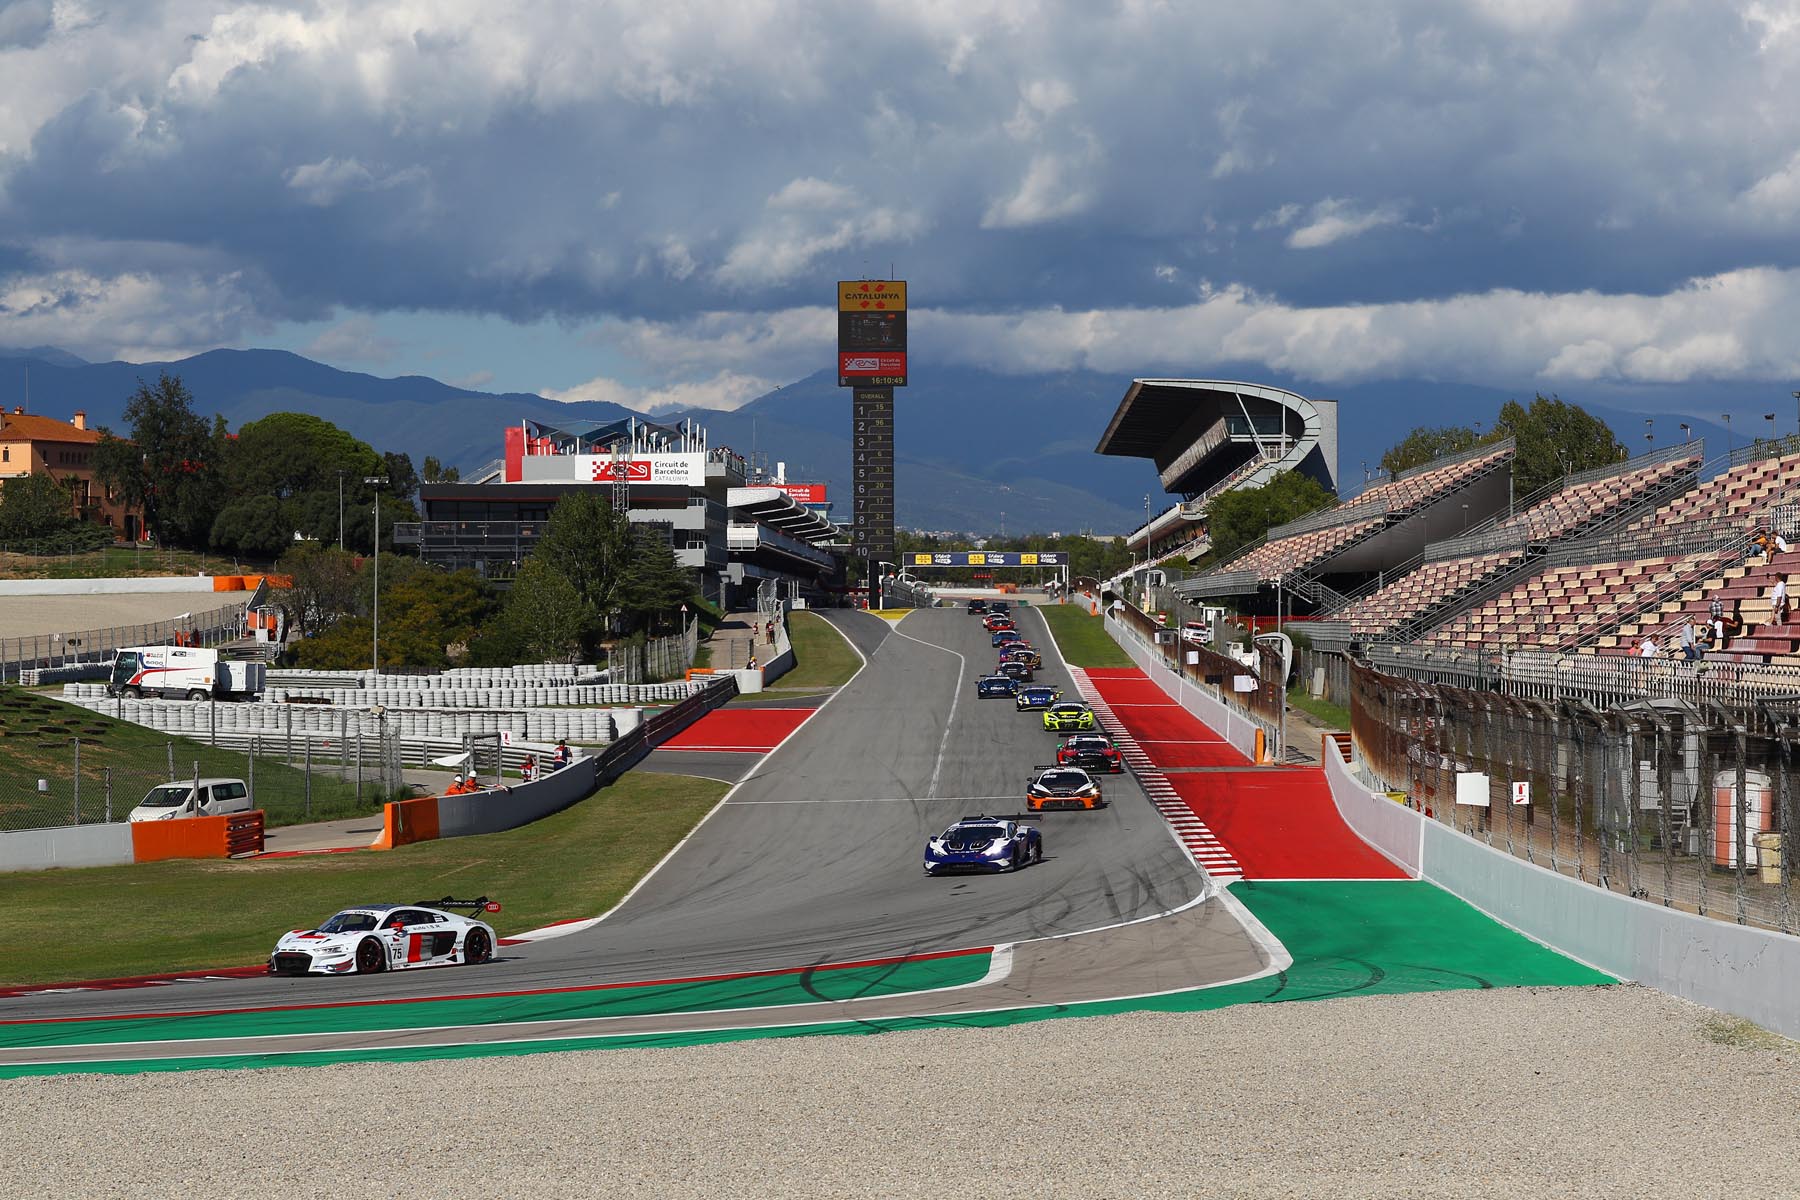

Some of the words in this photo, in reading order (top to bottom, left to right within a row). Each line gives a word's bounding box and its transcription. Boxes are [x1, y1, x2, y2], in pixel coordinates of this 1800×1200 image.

[859, 406, 864, 416] 1
[858, 422, 865, 431] 2
[858, 437, 865, 447] 3
[858, 453, 865, 462] 4
[859, 469, 865, 478] 5
[858, 484, 865, 493] 6
[859, 500, 864, 509] 7
[858, 516, 865, 525] 8
[859, 531, 865, 541] 9
[856, 547, 868, 556] 10
[392, 948, 402, 960] 75
